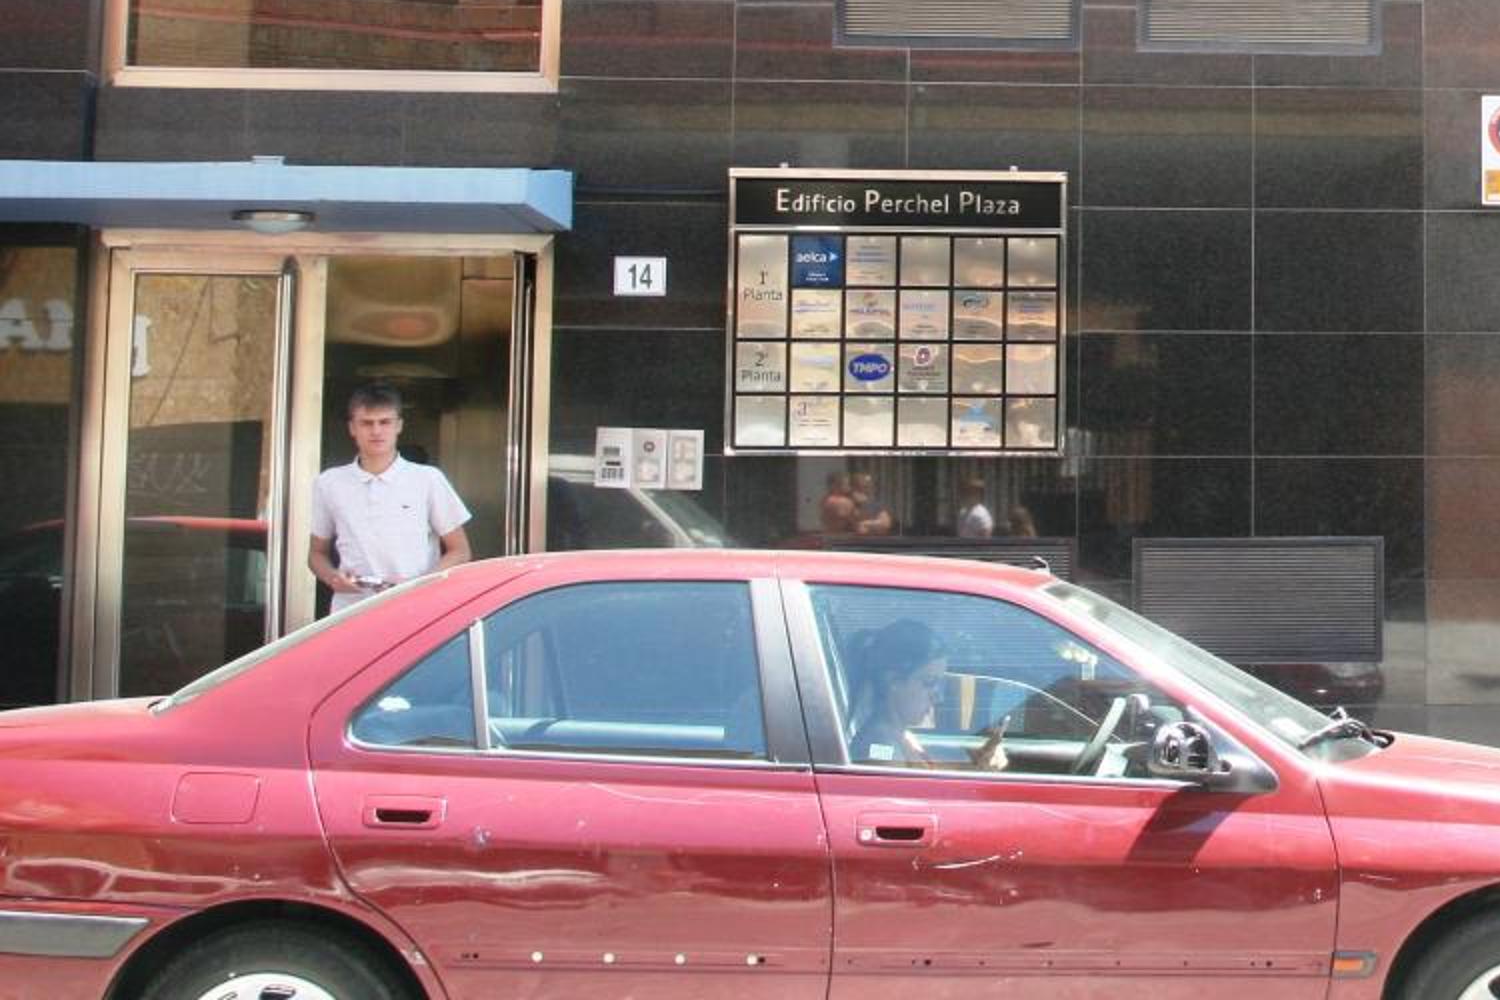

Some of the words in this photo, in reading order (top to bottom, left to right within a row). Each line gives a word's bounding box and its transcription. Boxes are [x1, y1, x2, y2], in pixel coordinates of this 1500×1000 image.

[775, 188, 855, 213] Edificio
[865, 189, 949, 214] Perchel
[959, 191, 1020, 215] Plaza
[628, 263, 653, 289] 14
[743, 288, 783, 301] Planta
[741, 370, 781, 382] Planta
